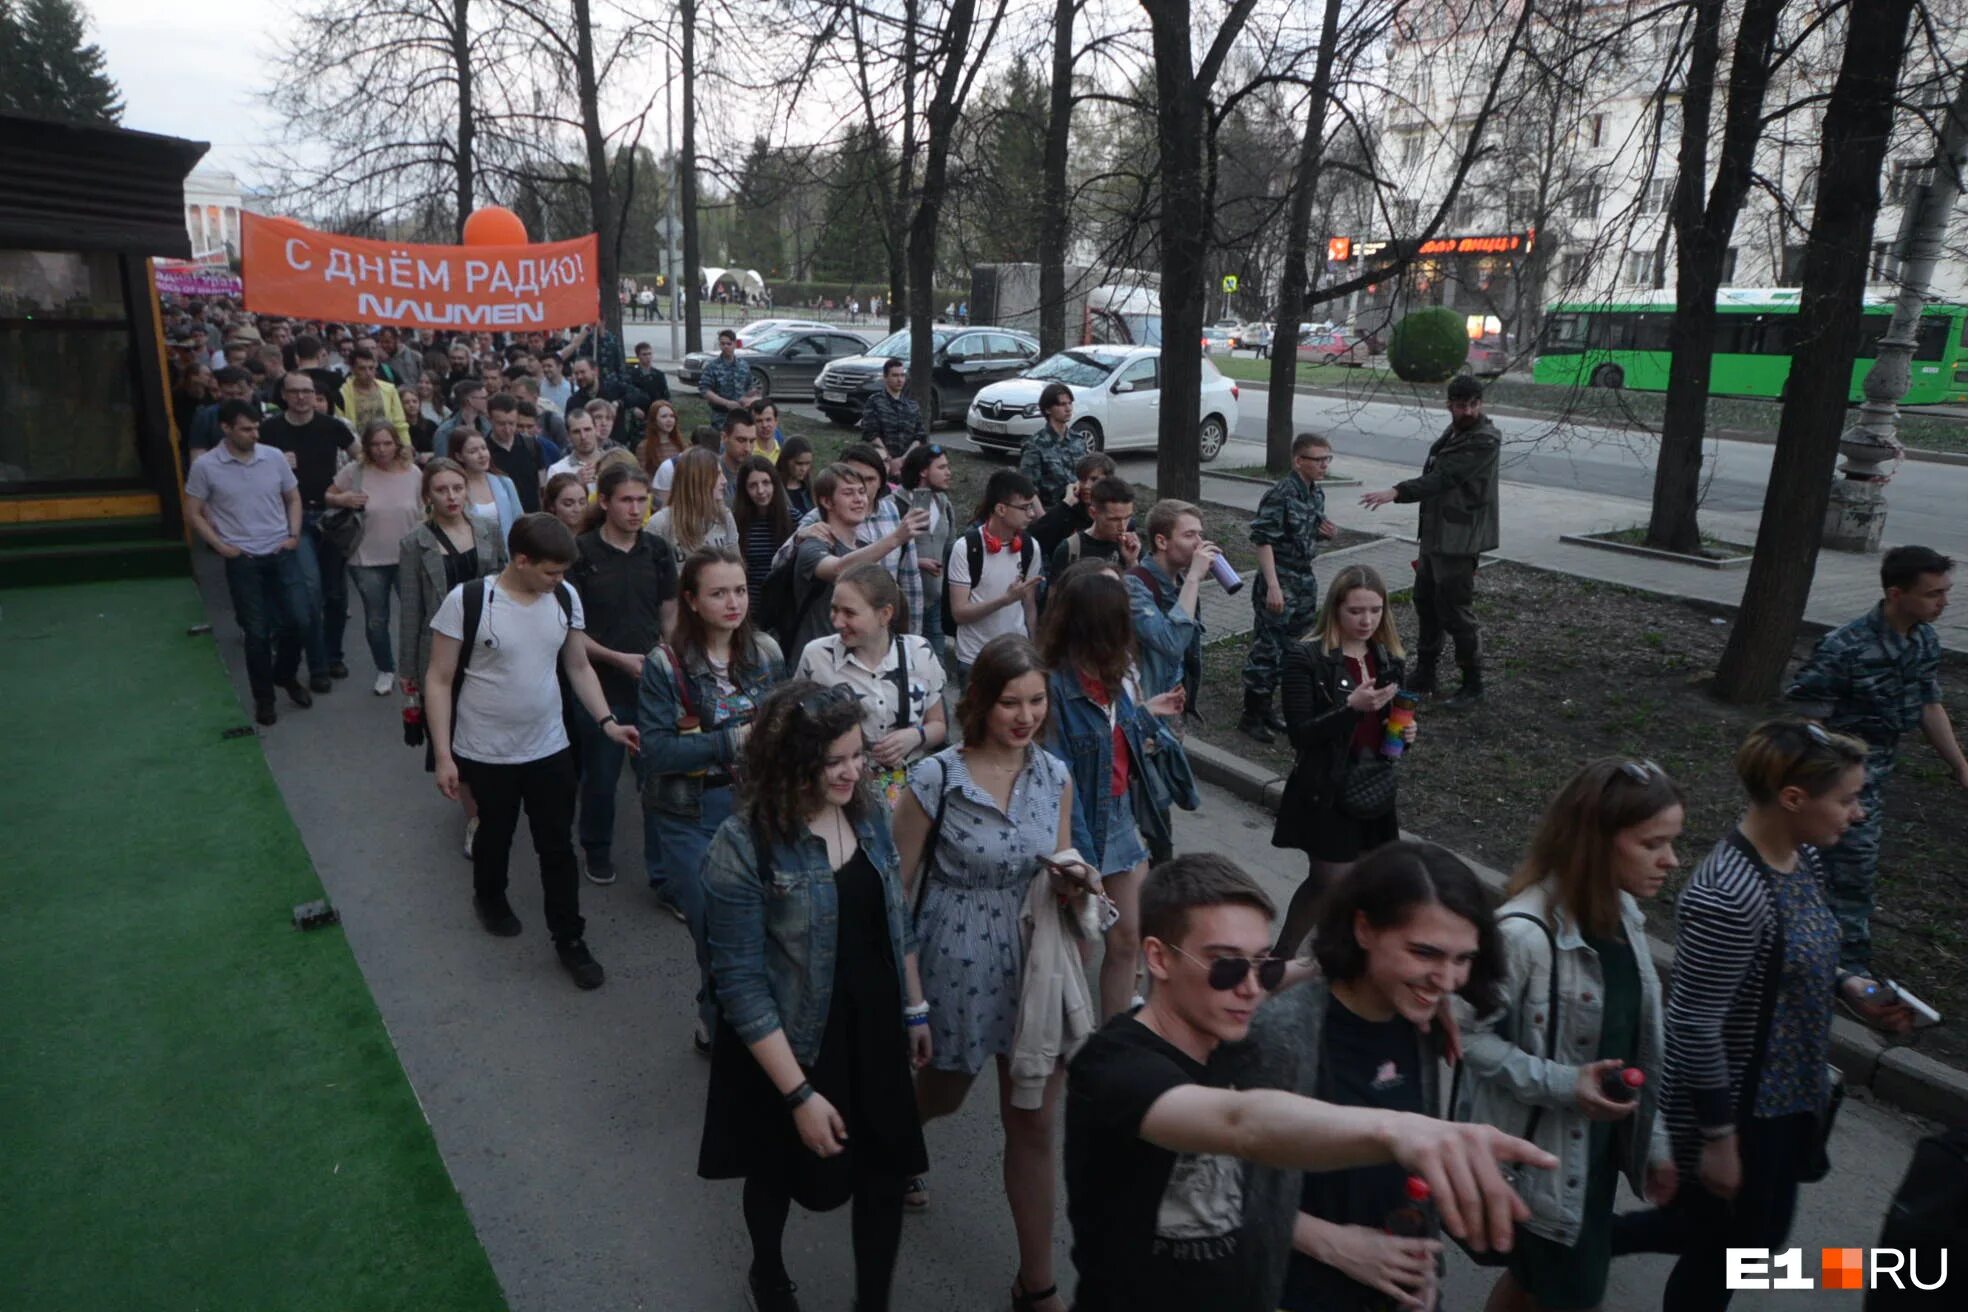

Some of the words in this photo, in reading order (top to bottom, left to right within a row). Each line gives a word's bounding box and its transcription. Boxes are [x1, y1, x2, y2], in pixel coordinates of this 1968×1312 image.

[284, 237, 312, 271] С
[324, 247, 450, 292] ДНЁМ
[465, 252, 585, 299] РАДИО!
[357, 292, 544, 326] NAUMEN
